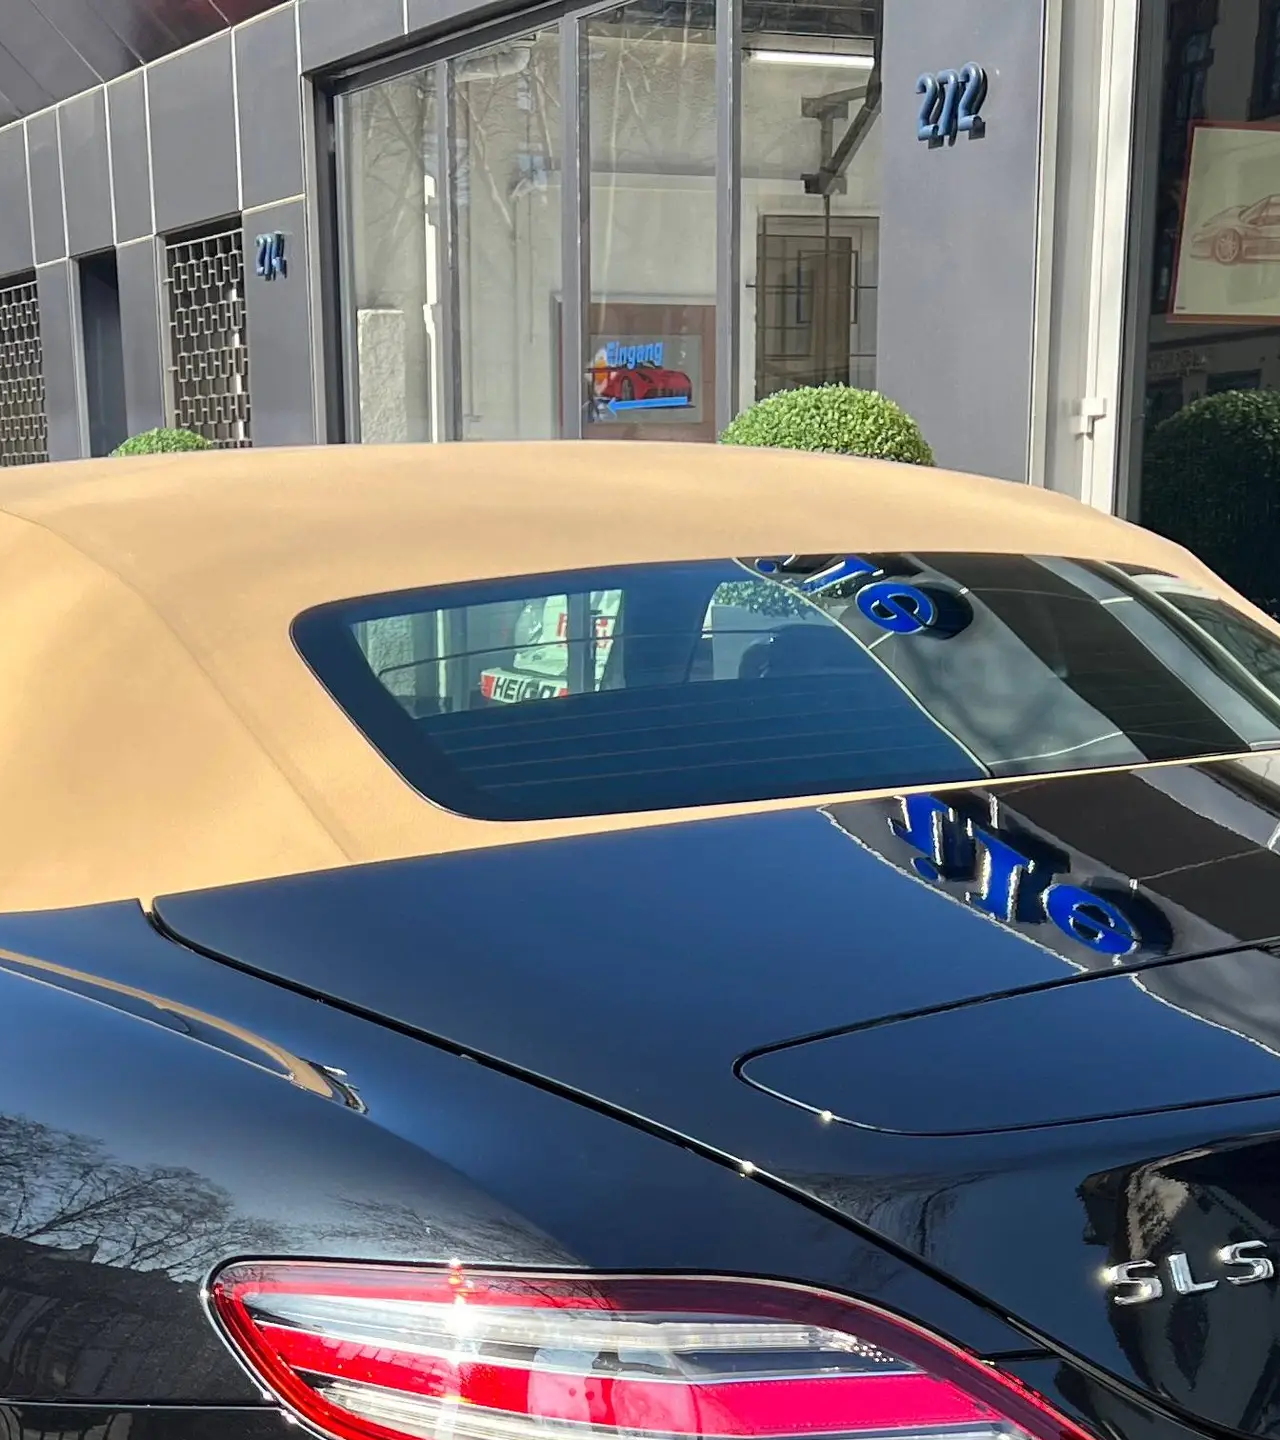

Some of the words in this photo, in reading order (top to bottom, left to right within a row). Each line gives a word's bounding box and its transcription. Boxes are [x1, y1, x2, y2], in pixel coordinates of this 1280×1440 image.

[916, 61, 985, 145] 272
[605, 341, 664, 369] Eingang
[1102, 1239, 1276, 1306] SLS
